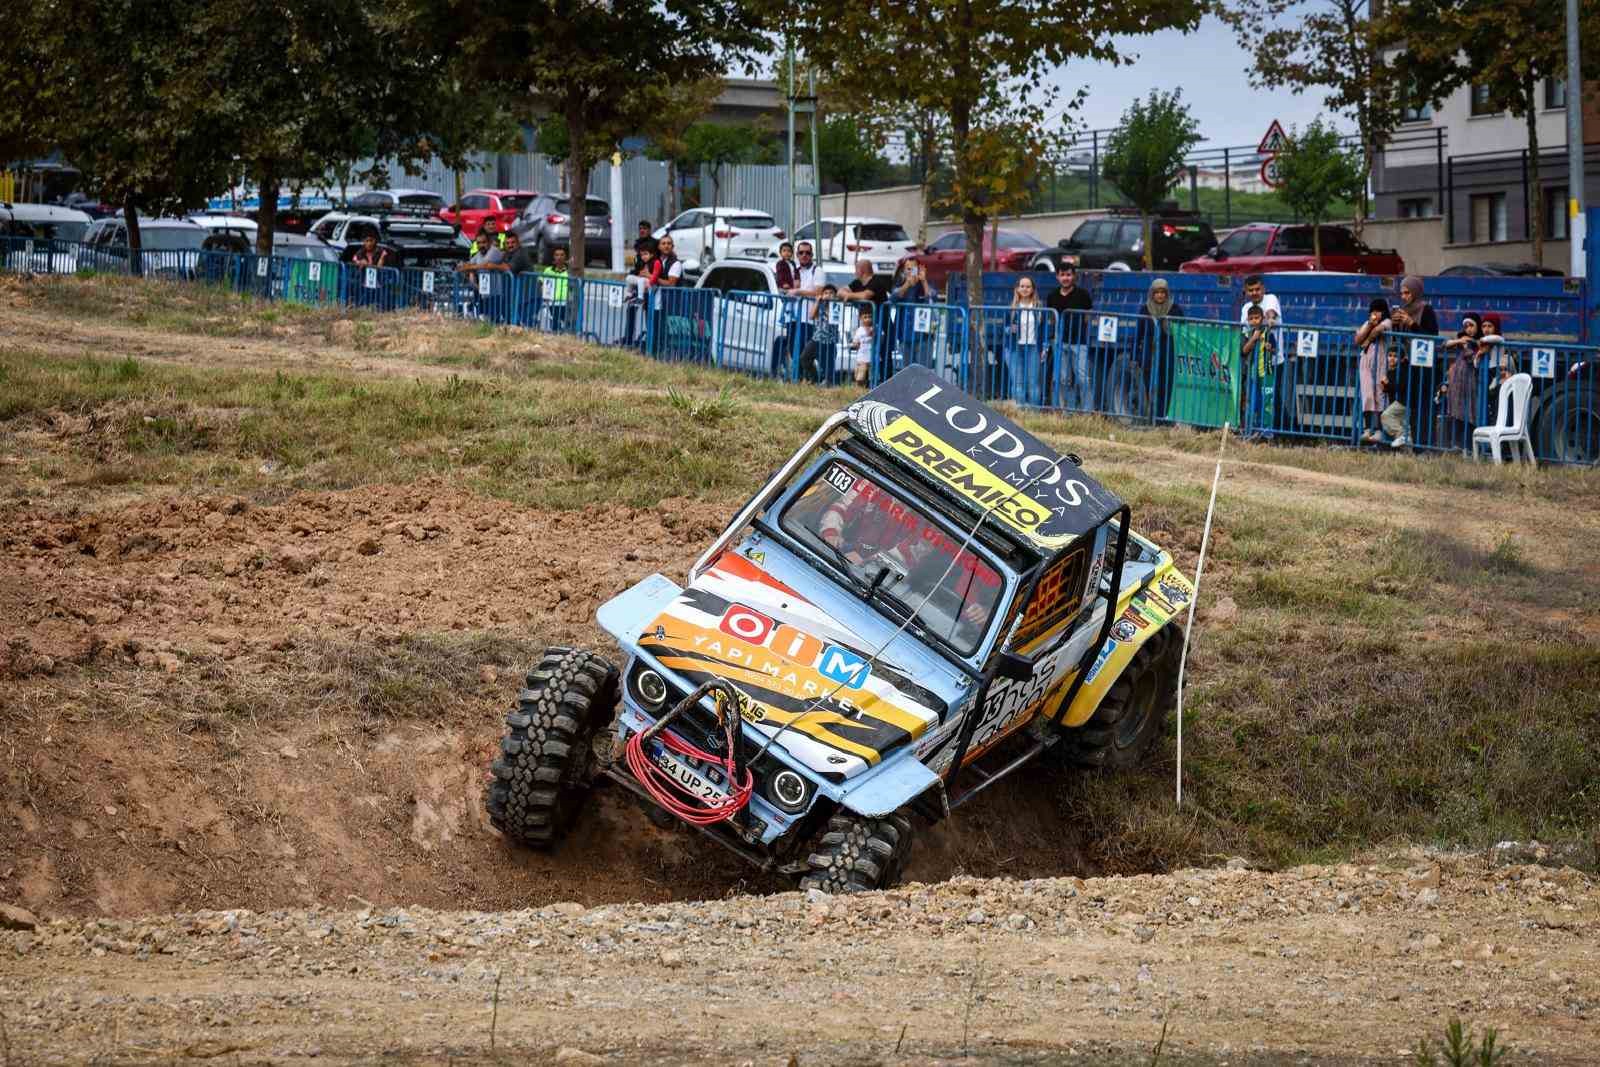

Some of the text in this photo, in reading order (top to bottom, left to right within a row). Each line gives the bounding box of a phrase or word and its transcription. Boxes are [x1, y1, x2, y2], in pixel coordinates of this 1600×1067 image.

[914, 384, 1090, 507] LODOS
[829, 467, 852, 492] 103
[890, 430, 1041, 526] PREMICO
[761, 661, 866, 720] MARKET
[660, 757, 677, 775] 34
[681, 769, 702, 789] UP
